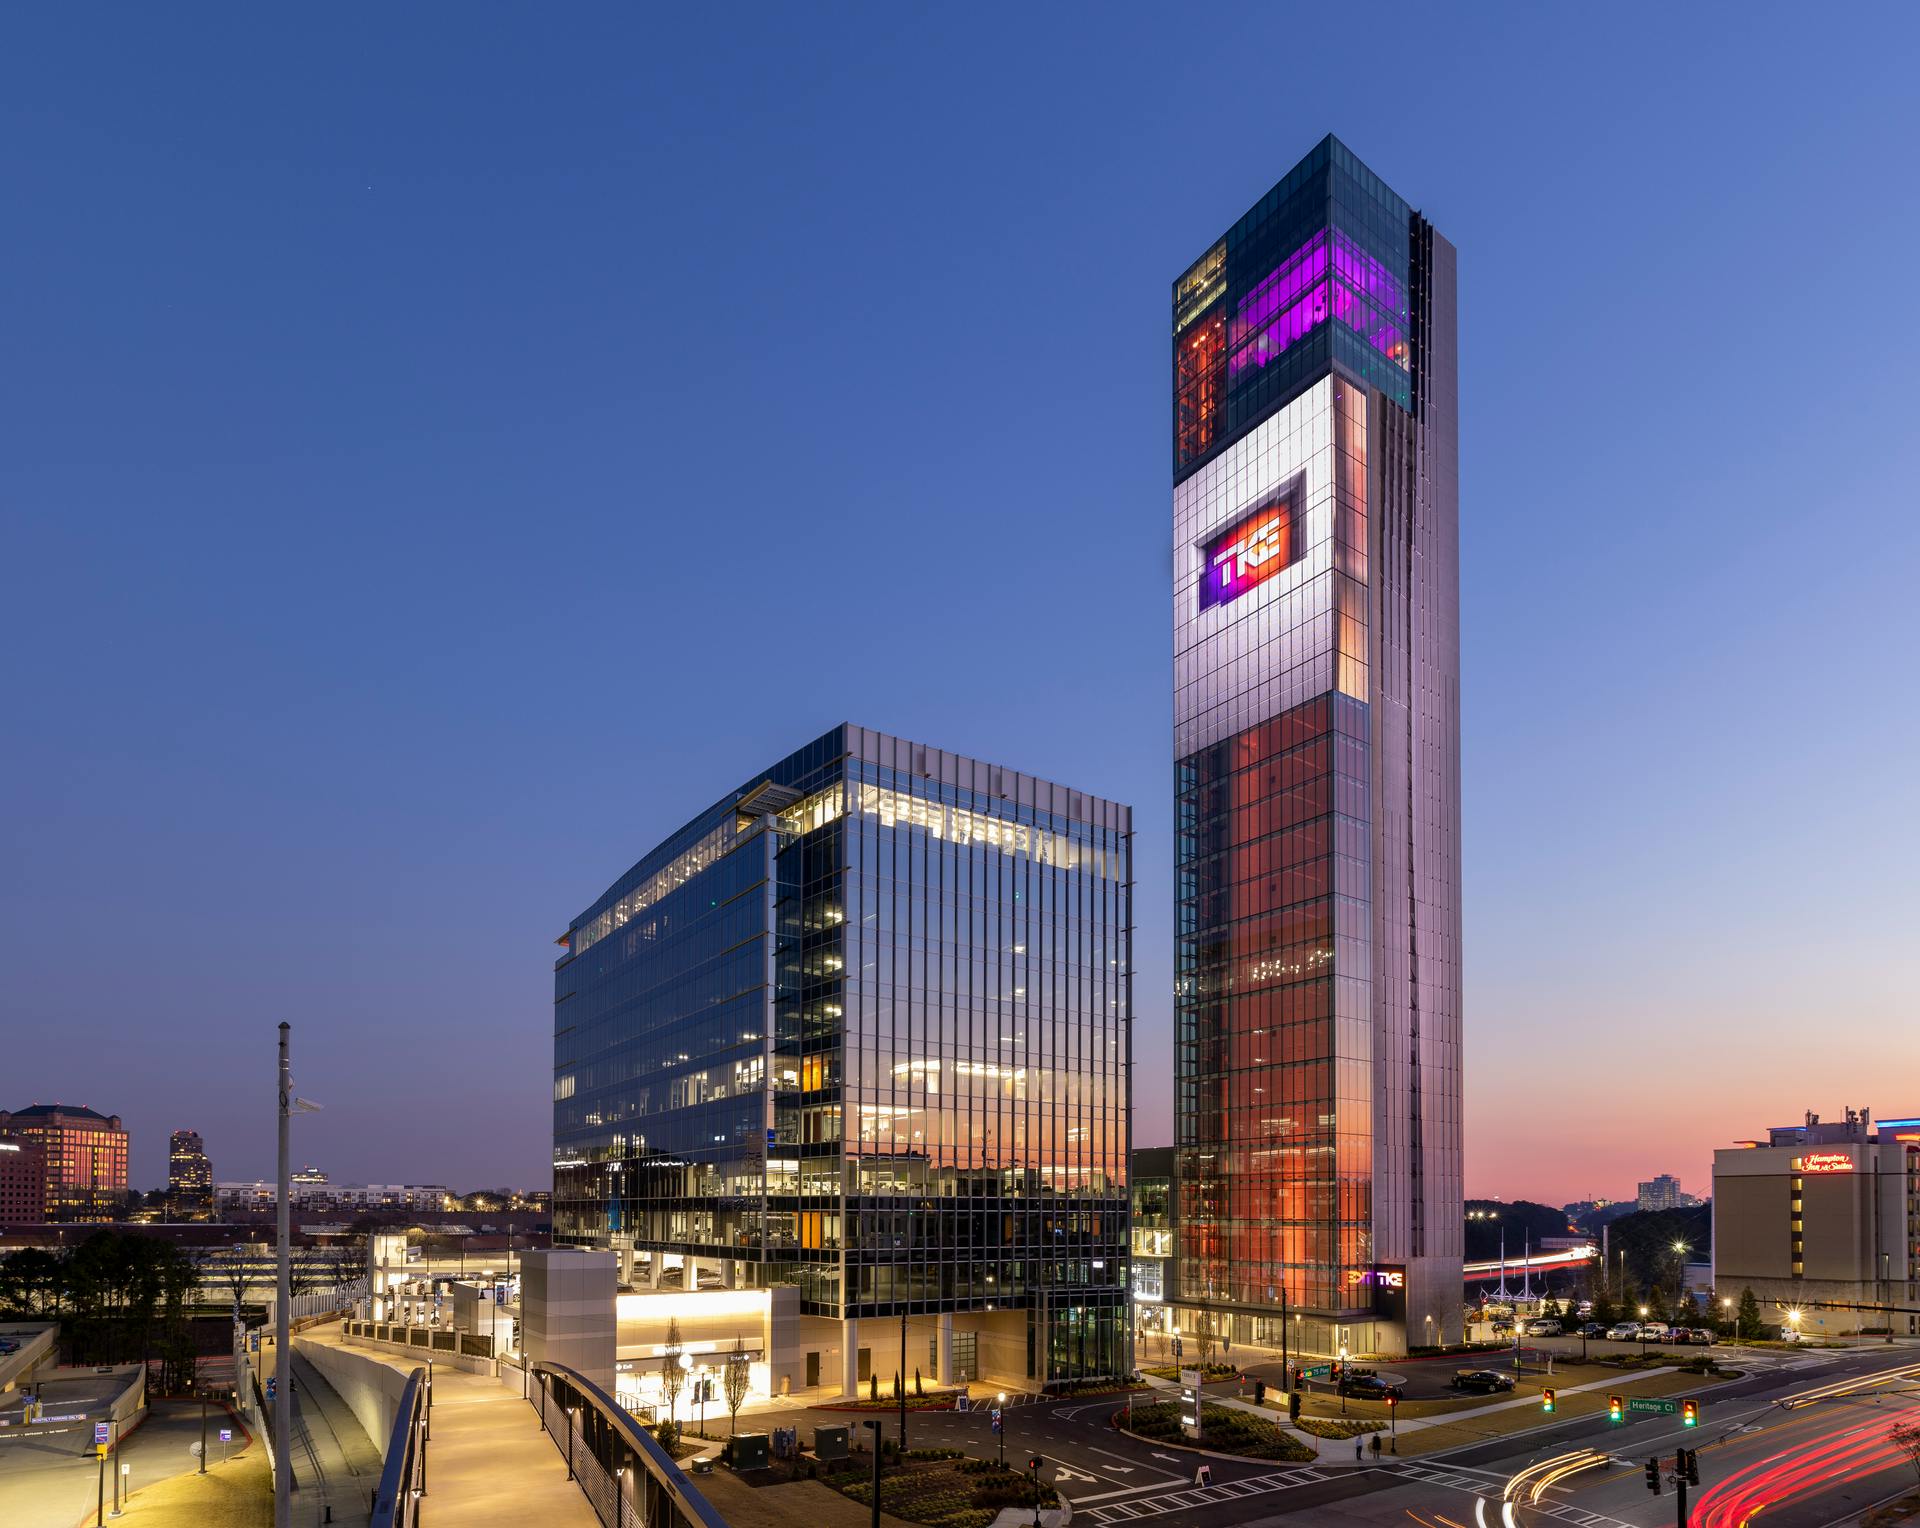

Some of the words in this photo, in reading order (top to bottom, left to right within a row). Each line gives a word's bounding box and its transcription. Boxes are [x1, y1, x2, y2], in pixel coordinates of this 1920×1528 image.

[1213, 517, 1280, 588] TKE
[1804, 1154, 1850, 1164] Hampton
[1801, 1163, 1824, 1172] Inn
[1829, 1162, 1853, 1171] Suites
[1376, 1271, 1403, 1287] TKE
[1632, 1401, 1661, 1412] Heritage
[1664, 1403, 1674, 1412] Ct
